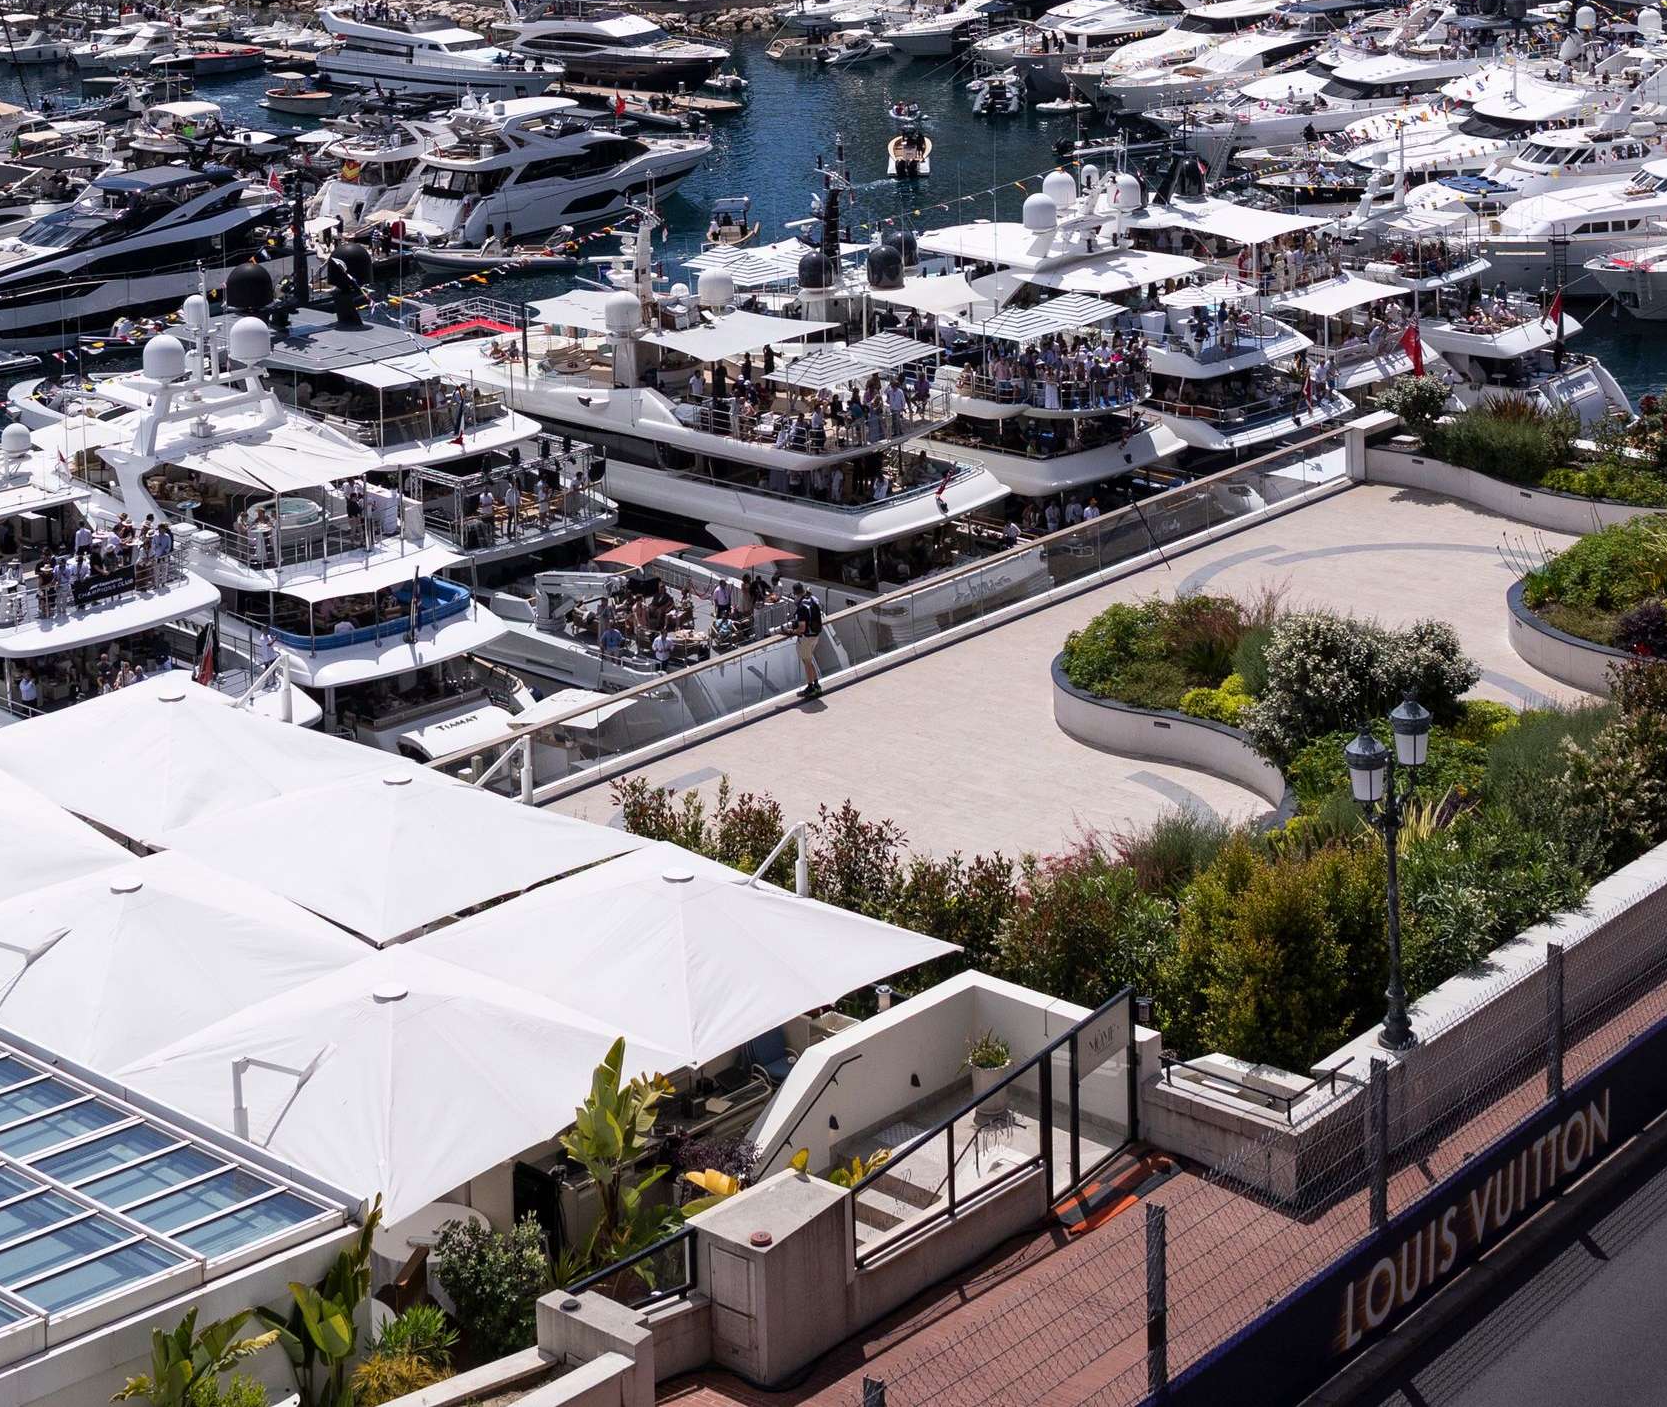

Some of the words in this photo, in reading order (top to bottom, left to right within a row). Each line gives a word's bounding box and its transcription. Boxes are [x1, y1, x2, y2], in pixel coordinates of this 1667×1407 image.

[436, 715, 479, 731] TIAMAT
[1345, 1206, 1457, 1349] LOUIS
[1471, 1089, 1609, 1243] VUITTON
